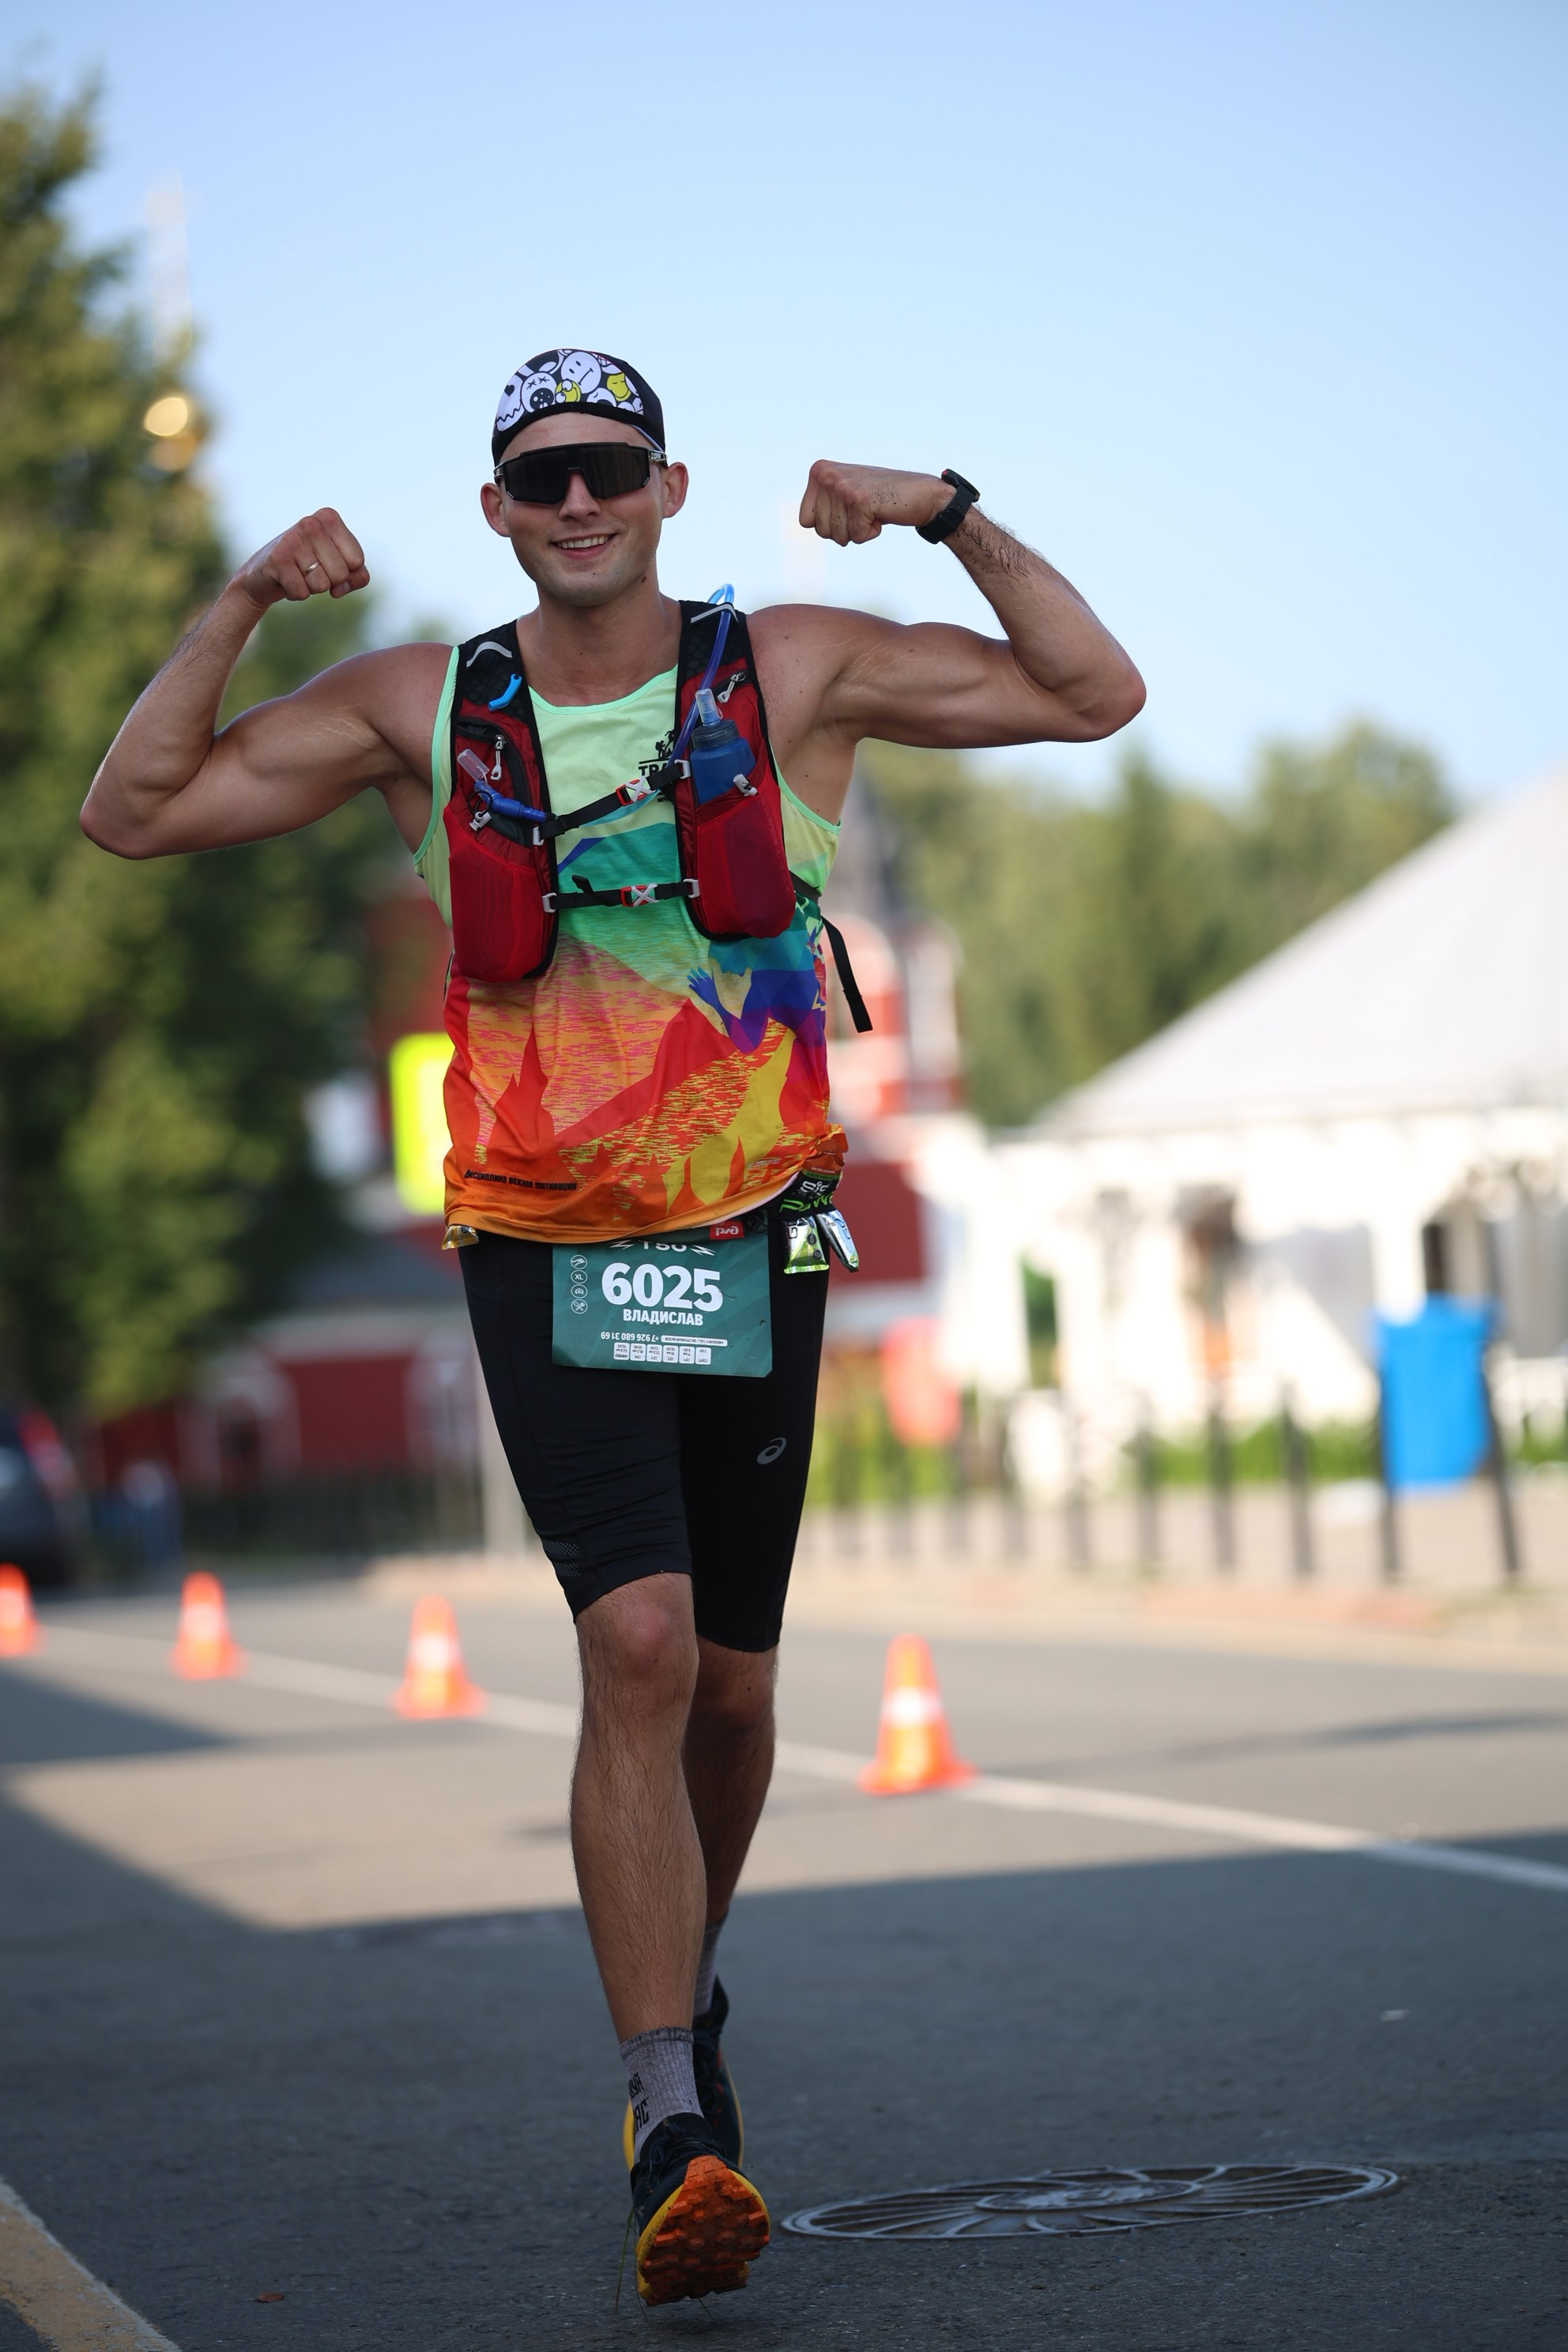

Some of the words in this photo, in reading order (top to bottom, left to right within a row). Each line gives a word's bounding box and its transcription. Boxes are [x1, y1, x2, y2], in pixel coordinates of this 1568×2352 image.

[601, 1262, 723, 1312] 6025
[623, 1309, 703, 1325] ВЛАДИСЛАВ
[601, 1331, 610, 1340] 69
[612, 1332, 620, 1340] 31
[621, 1332, 635, 1341] 680
[636, 1333, 650, 1342] 926
[651, 1334, 659, 1343] +7
